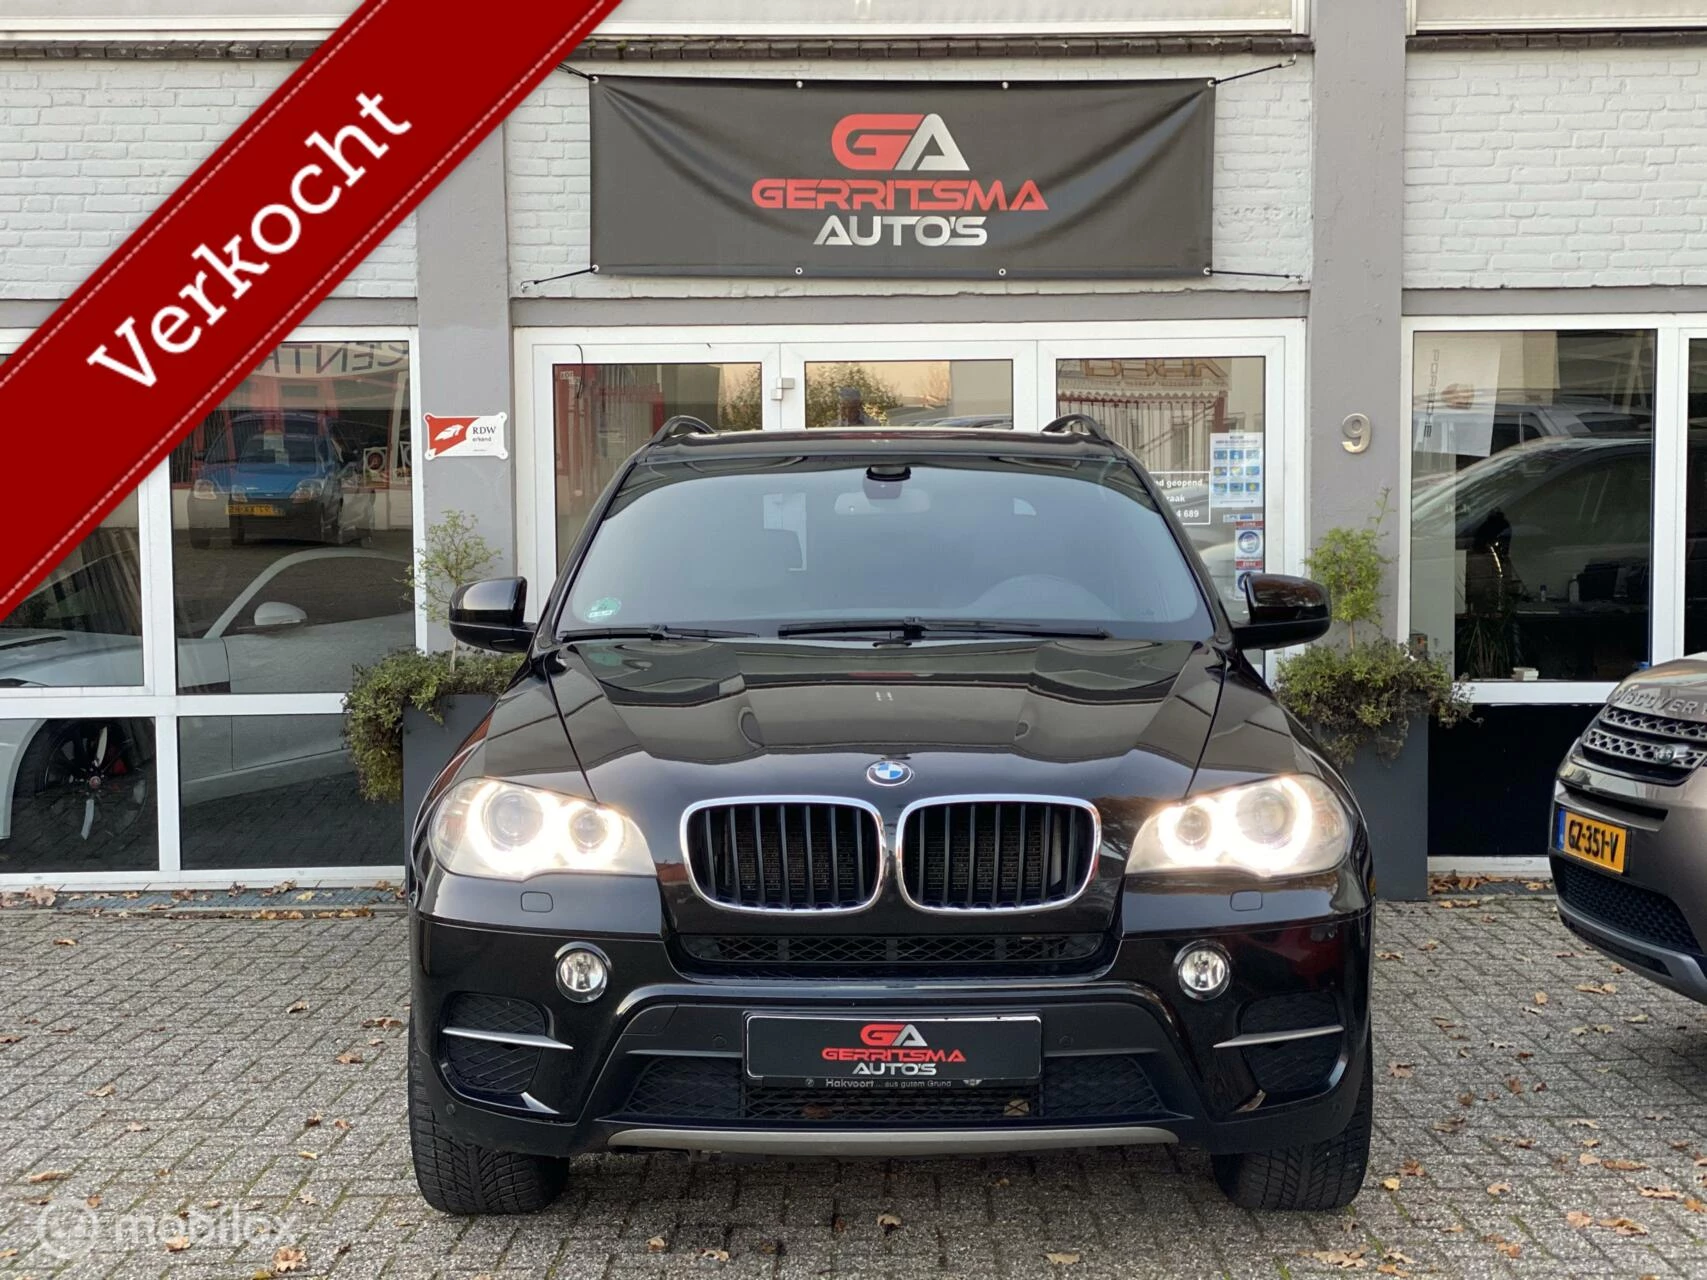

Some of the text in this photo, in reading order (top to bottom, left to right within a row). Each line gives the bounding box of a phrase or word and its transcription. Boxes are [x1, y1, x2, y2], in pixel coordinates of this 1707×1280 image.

[831, 113, 970, 171] GA
[751, 178, 1049, 211] GERRITSMA
[813, 214, 987, 247] AUTO'S
[472, 426, 497, 435] RDW
[1341, 413, 1373, 454] 9
[1166, 479, 1203, 489] geopend
[1183, 509, 1200, 518] 689
[1614, 684, 1707, 715] DISCOVER
[1568, 820, 1620, 863] GZ-351-V
[859, 1023, 928, 1047] GA
[821, 1047, 967, 1062] GERRITSMA
[851, 1062, 937, 1076] AUTO'S
[825, 1078, 874, 1088] Hakvoort
[927, 1079, 952, 1088] Grund
